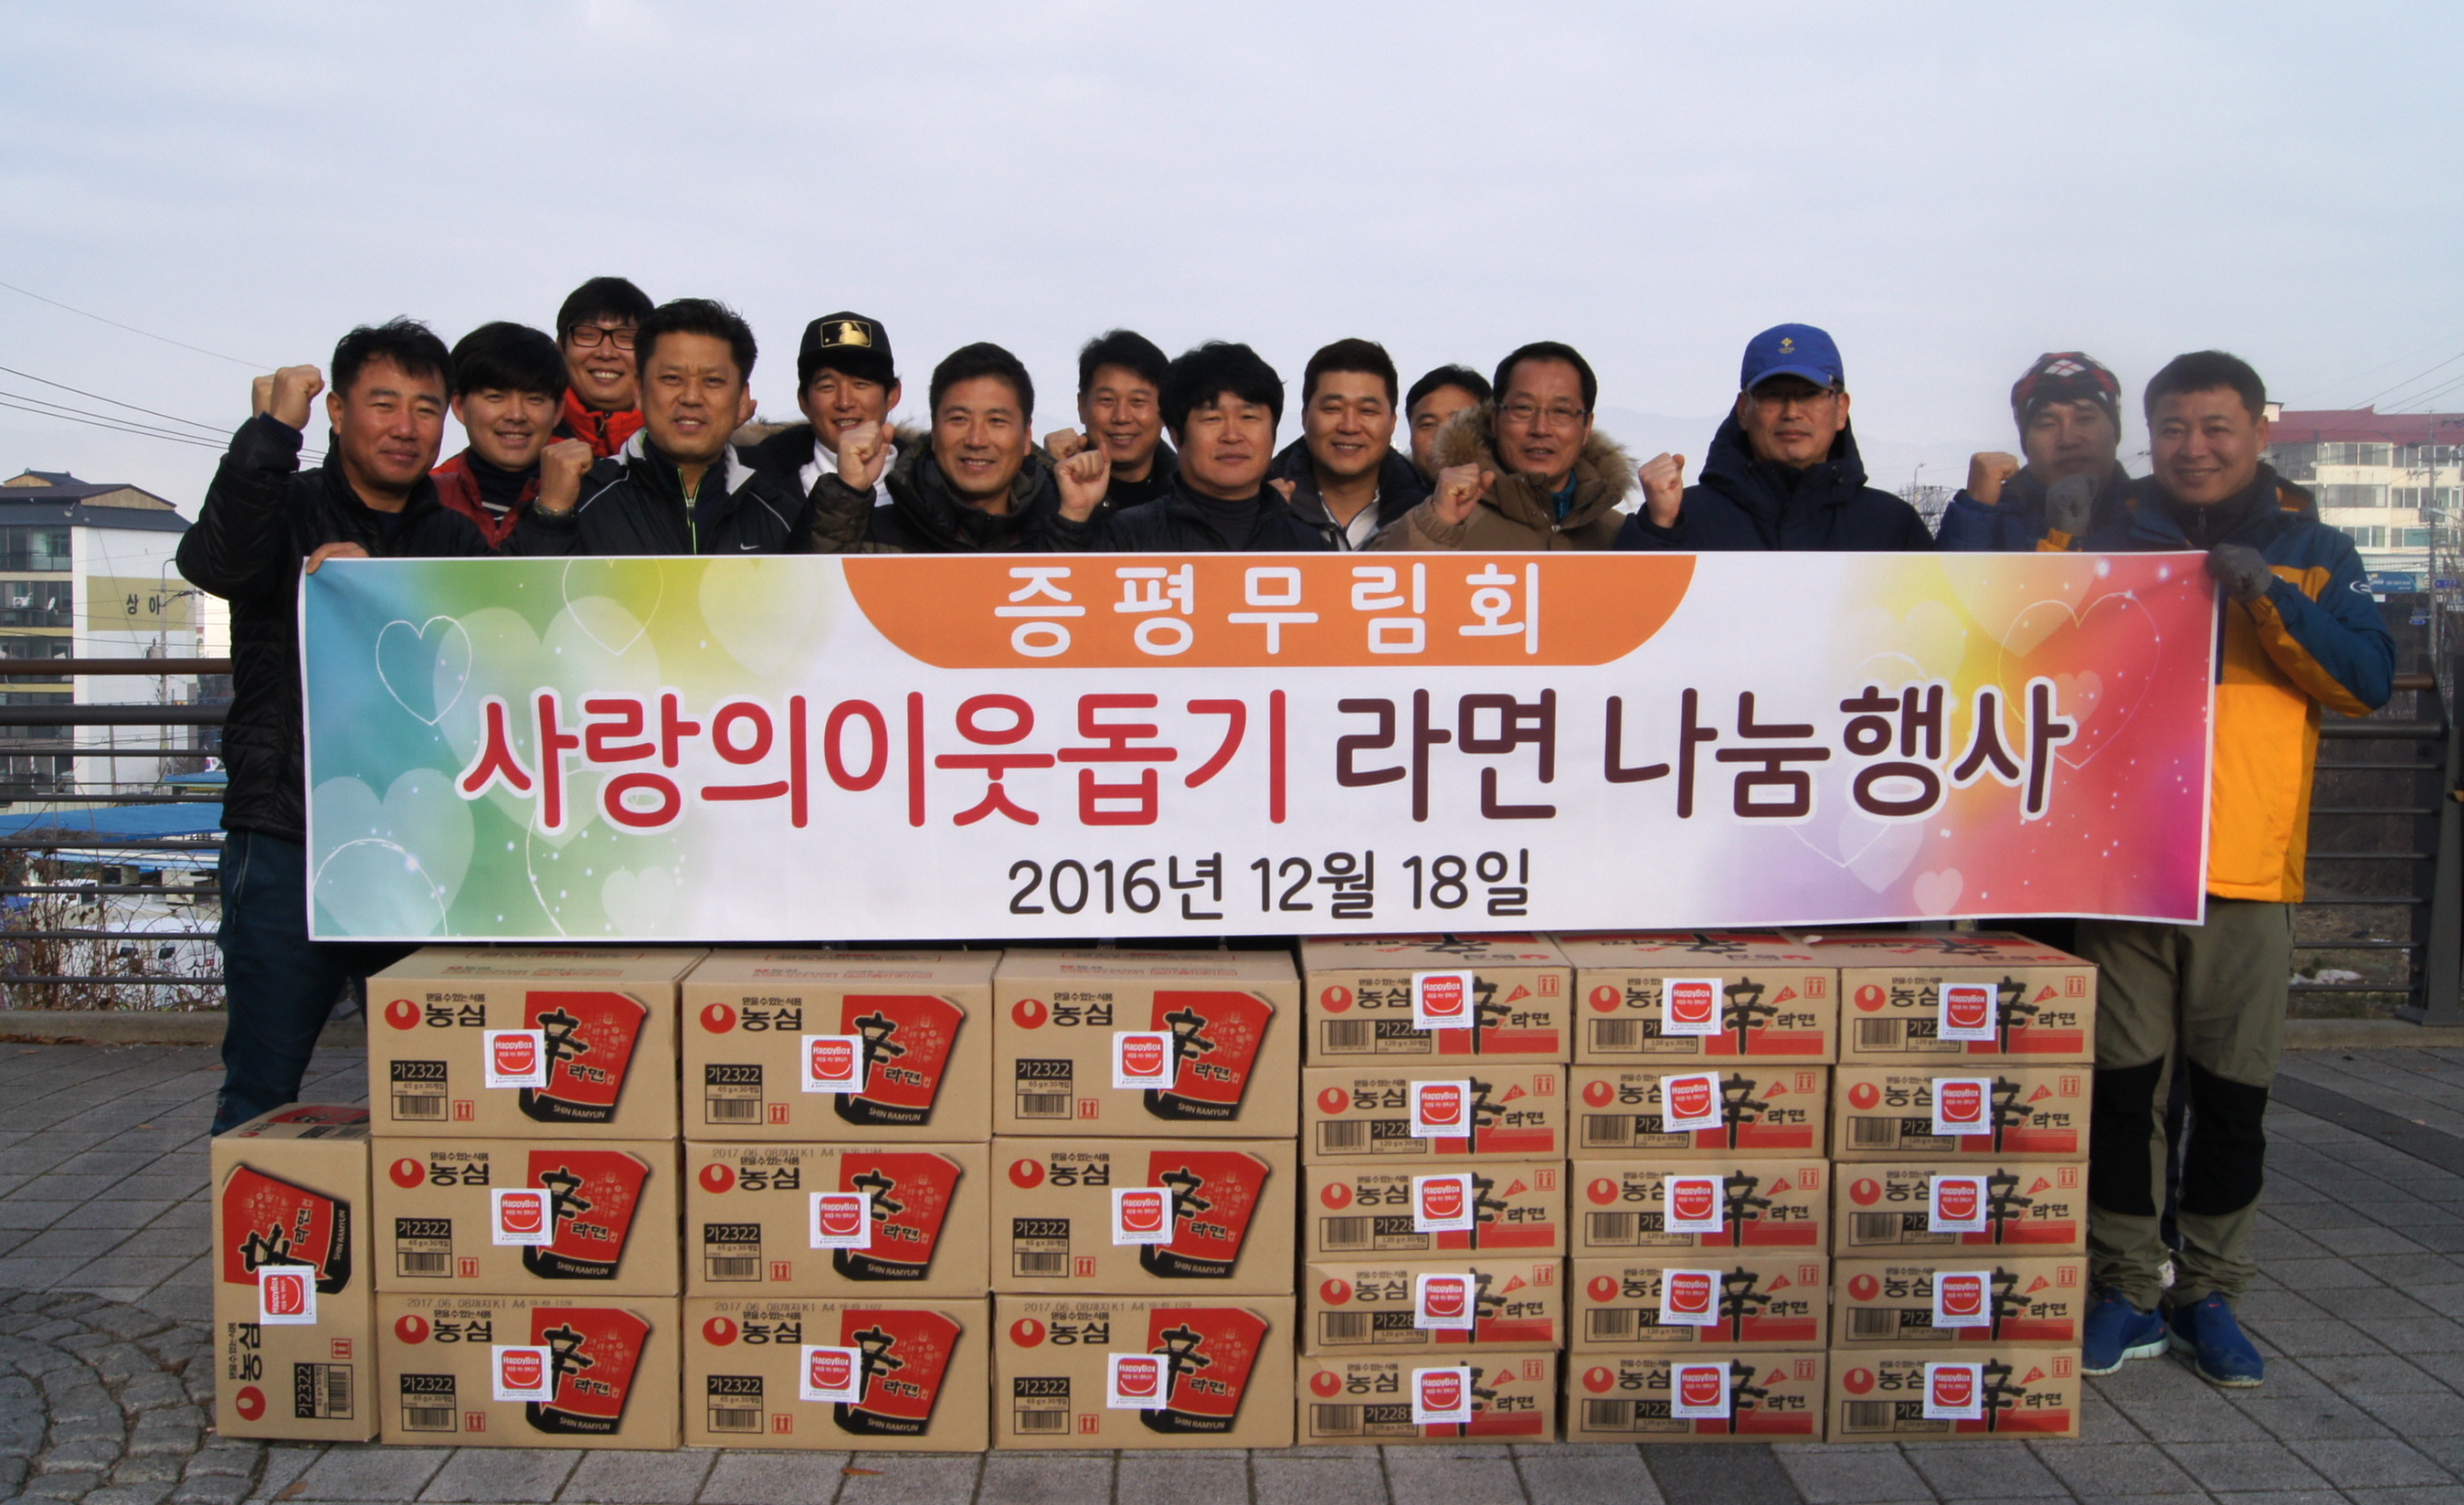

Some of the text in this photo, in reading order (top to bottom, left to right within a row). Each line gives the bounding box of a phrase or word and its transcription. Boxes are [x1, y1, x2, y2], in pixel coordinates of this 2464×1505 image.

[995, 562, 1539, 657] 증평무림회
[461, 684, 2071, 829] 사랑의이웃돕기 라면 나눔행사
[1010, 849, 1529, 921] 2016년 12월 18일
[1423, 982, 1460, 991] HappyBox
[1674, 989, 1709, 997] HappyBox
[1358, 989, 1411, 1008] 농심
[1950, 994, 1985, 1003] HappyBox
[426, 1004, 485, 1027] 농심
[742, 1009, 801, 1031] 농심
[1052, 1003, 1113, 1026] 농심
[1511, 1012, 1550, 1027] 라면
[1777, 1013, 1815, 1029] 라면
[2039, 1012, 2076, 1028] 라면
[495, 1041, 533, 1050] HappyBox
[813, 1046, 850, 1055] HappyBox
[1124, 1043, 1160, 1051] HappyBox
[393, 1064, 444, 1080] 가2322
[568, 1064, 605, 1083] 라면
[708, 1067, 759, 1083] 가2322
[885, 1068, 920, 1086] 라면
[1020, 1062, 1069, 1077] 가2322
[1195, 1063, 1230, 1080] 라면
[1422, 1091, 1458, 1100] HappyBox
[1672, 1085, 1708, 1094] HappyBox
[1943, 1088, 1979, 1097] HappyBox
[1353, 1088, 1406, 1108] 농심
[553, 1105, 571, 1115] SHIN
[869, 1108, 886, 1118] SHIN
[1178, 1103, 1195, 1113] SHIN
[1768, 1108, 1805, 1124] 라면
[1507, 1111, 1544, 1127] 라면
[2033, 1112, 2070, 1128] 라면
[430, 1163, 489, 1185] 농심
[739, 1168, 799, 1190] 농심
[1050, 1163, 1110, 1185] 농심
[1356, 1184, 1409, 1205] 농심
[1423, 1185, 1460, 1194] HappyBox
[1676, 1186, 1710, 1195] HappyBox
[1941, 1186, 1974, 1195] HappyBox
[502, 1199, 538, 1208] HappyBox
[821, 1203, 858, 1211] HappyBox
[1123, 1199, 1159, 1207] HappyBox
[2032, 1203, 2068, 1219] 라면
[1507, 1207, 1546, 1223] 라면
[1771, 1205, 1808, 1221] 라면
[293, 1209, 312, 1245] 라면
[399, 1221, 449, 1237] 가2322
[572, 1223, 608, 1240] 라면
[706, 1225, 757, 1241] 가2322
[884, 1224, 919, 1242] 라면
[1016, 1221, 1066, 1236] 가2322
[1190, 1222, 1227, 1238] 라면
[333, 1243, 344, 1260] SHIN
[557, 1262, 574, 1272] SHIN
[867, 1264, 884, 1274] SHIN
[1174, 1261, 1191, 1271] SHIN
[1355, 1280, 1408, 1300] 농심
[1427, 1285, 1463, 1293] HappyBox
[1673, 1279, 1708, 1288] HappyBox
[1507, 1302, 1544, 1318] 라면
[1771, 1301, 1808, 1316] 라면
[2031, 1303, 2067, 1319] 라면
[433, 1321, 492, 1342] 농심
[743, 1322, 801, 1344] 농심
[1050, 1322, 1109, 1344] 농심
[239, 1321, 262, 1381] 농심
[503, 1356, 539, 1365] HappyBox
[812, 1356, 849, 1365] HappyBox
[1119, 1364, 1156, 1373] HappyBox
[404, 1377, 452, 1393] 가2322
[1190, 1377, 1226, 1394] 라면
[1347, 1373, 1398, 1393] 농심
[1422, 1378, 1459, 1387] HappyBox
[1619, 1370, 1671, 1389] 농심
[1683, 1373, 1718, 1383] HappyBox
[1935, 1373, 1971, 1382] HappyBox
[299, 1366, 312, 1415] 가2322
[575, 1378, 608, 1396] 라면
[710, 1378, 760, 1394] 가2322
[883, 1380, 919, 1397] 라면
[1017, 1380, 1067, 1394] 가2322
[1496, 1395, 1534, 1410] 라면
[1768, 1395, 1804, 1410] 라면
[2025, 1393, 2062, 1409] 라면
[560, 1417, 576, 1426] SHIN
[868, 1418, 884, 1428] SHIN
[1174, 1417, 1191, 1426] SHIN
